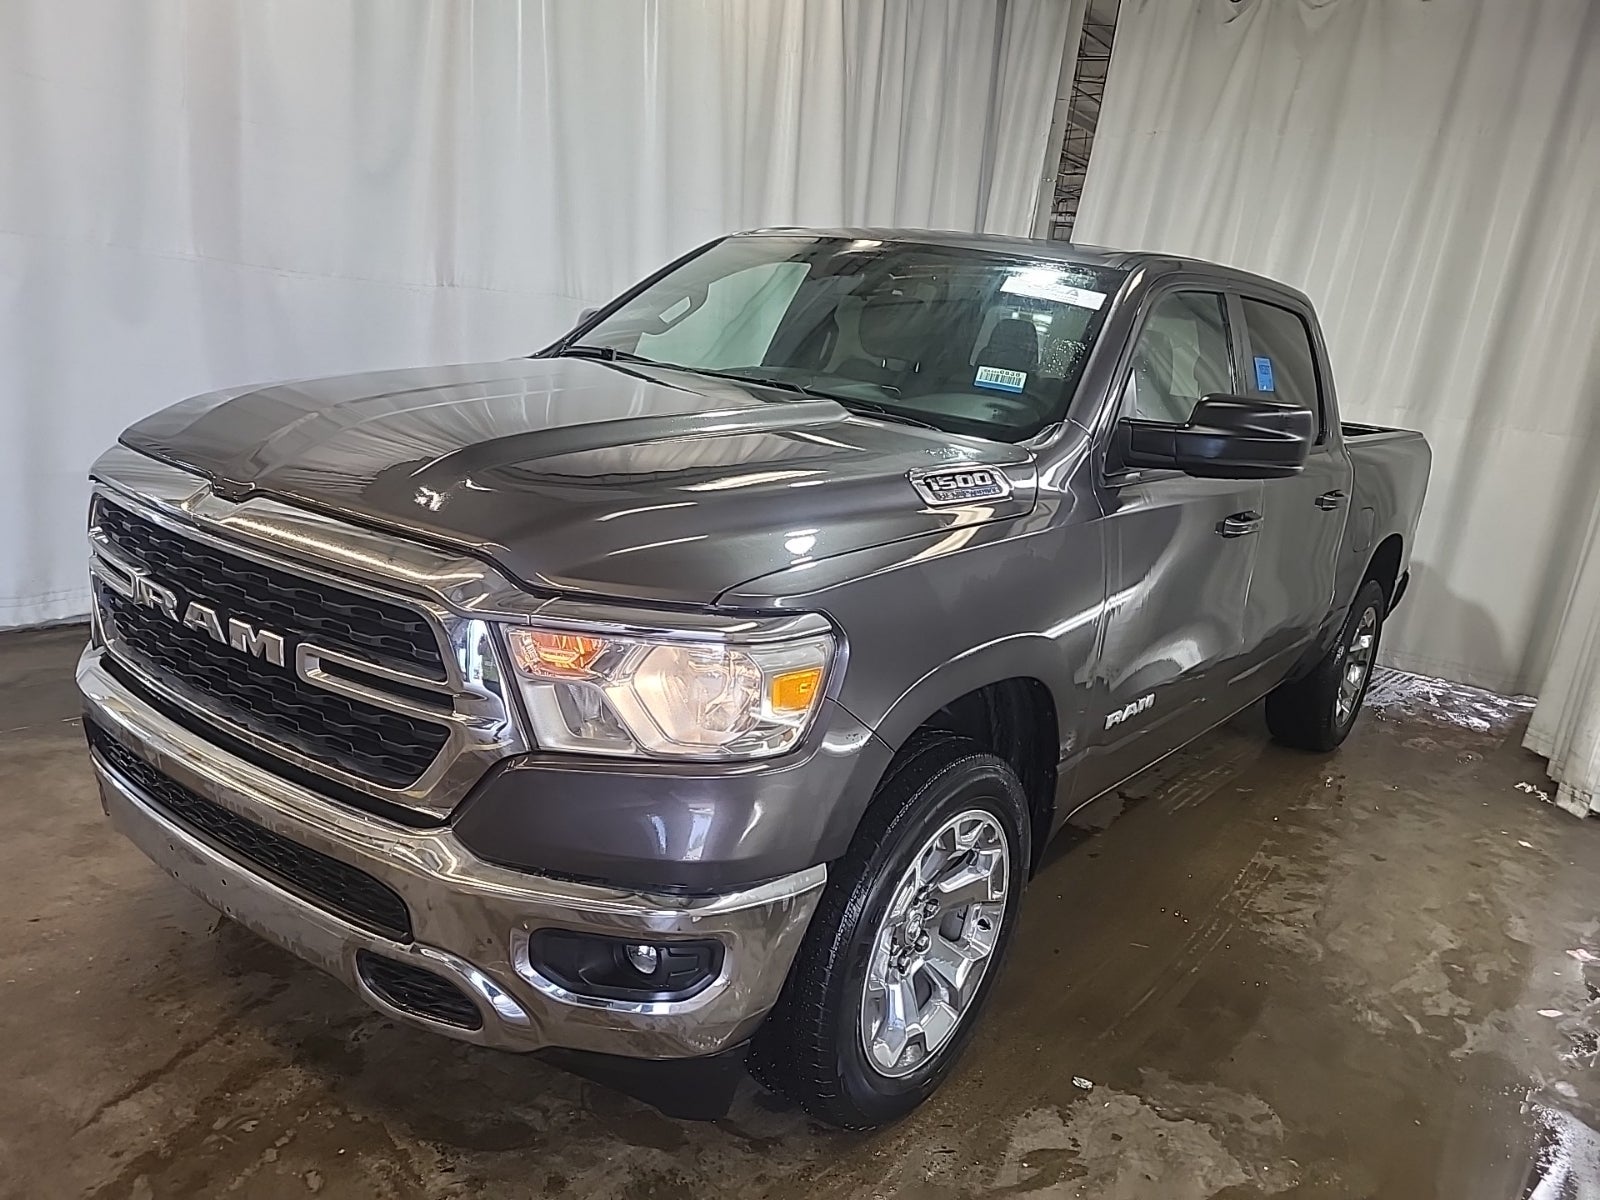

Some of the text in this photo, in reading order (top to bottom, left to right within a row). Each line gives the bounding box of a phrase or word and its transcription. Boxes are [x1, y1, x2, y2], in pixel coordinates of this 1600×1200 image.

[925, 472, 993, 491] 1500
[138, 577, 286, 668] RAM
[1104, 693, 1155, 730] RAM
